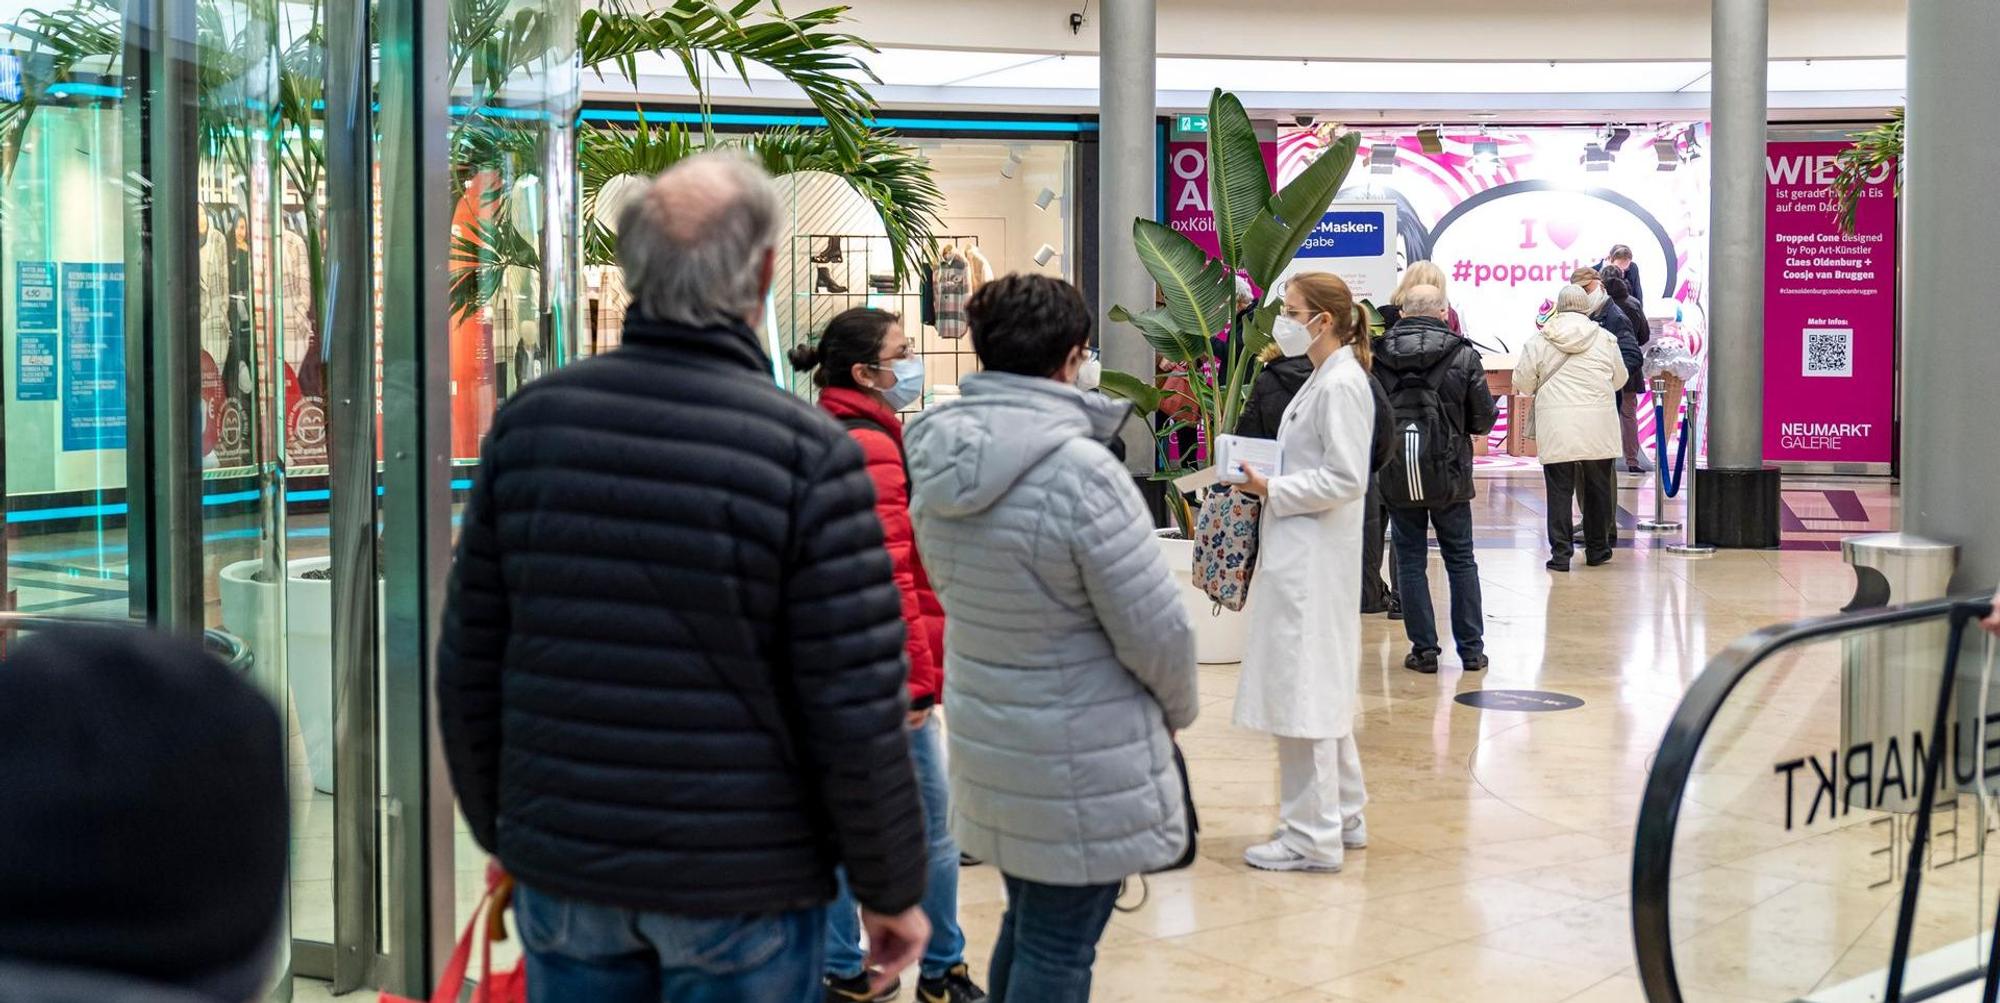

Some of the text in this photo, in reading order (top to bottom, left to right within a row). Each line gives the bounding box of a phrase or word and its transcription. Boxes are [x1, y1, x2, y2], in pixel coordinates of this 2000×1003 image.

[1776, 188, 1788, 198] ist
[1791, 188, 1826, 200] gerade
[1868, 187, 1884, 198] Eis
[1776, 202, 1792, 212] auf
[1794, 202, 1816, 212] dem
[1312, 221, 1378, 233] -Masken-
[1776, 233, 1883, 245] Dropped Cone designed
[1786, 245, 1872, 256] by Pop Art-Künstler
[1786, 257, 1872, 268] Claes Oldenburg +
[1452, 259, 1579, 287] #popart
[1783, 269, 1875, 281] Coosje van Bruggen
[1807, 317, 1849, 326] Mehr Infos:
[1781, 423, 1872, 437] NEUMARKT
[1781, 436, 1841, 450] GALERIE
